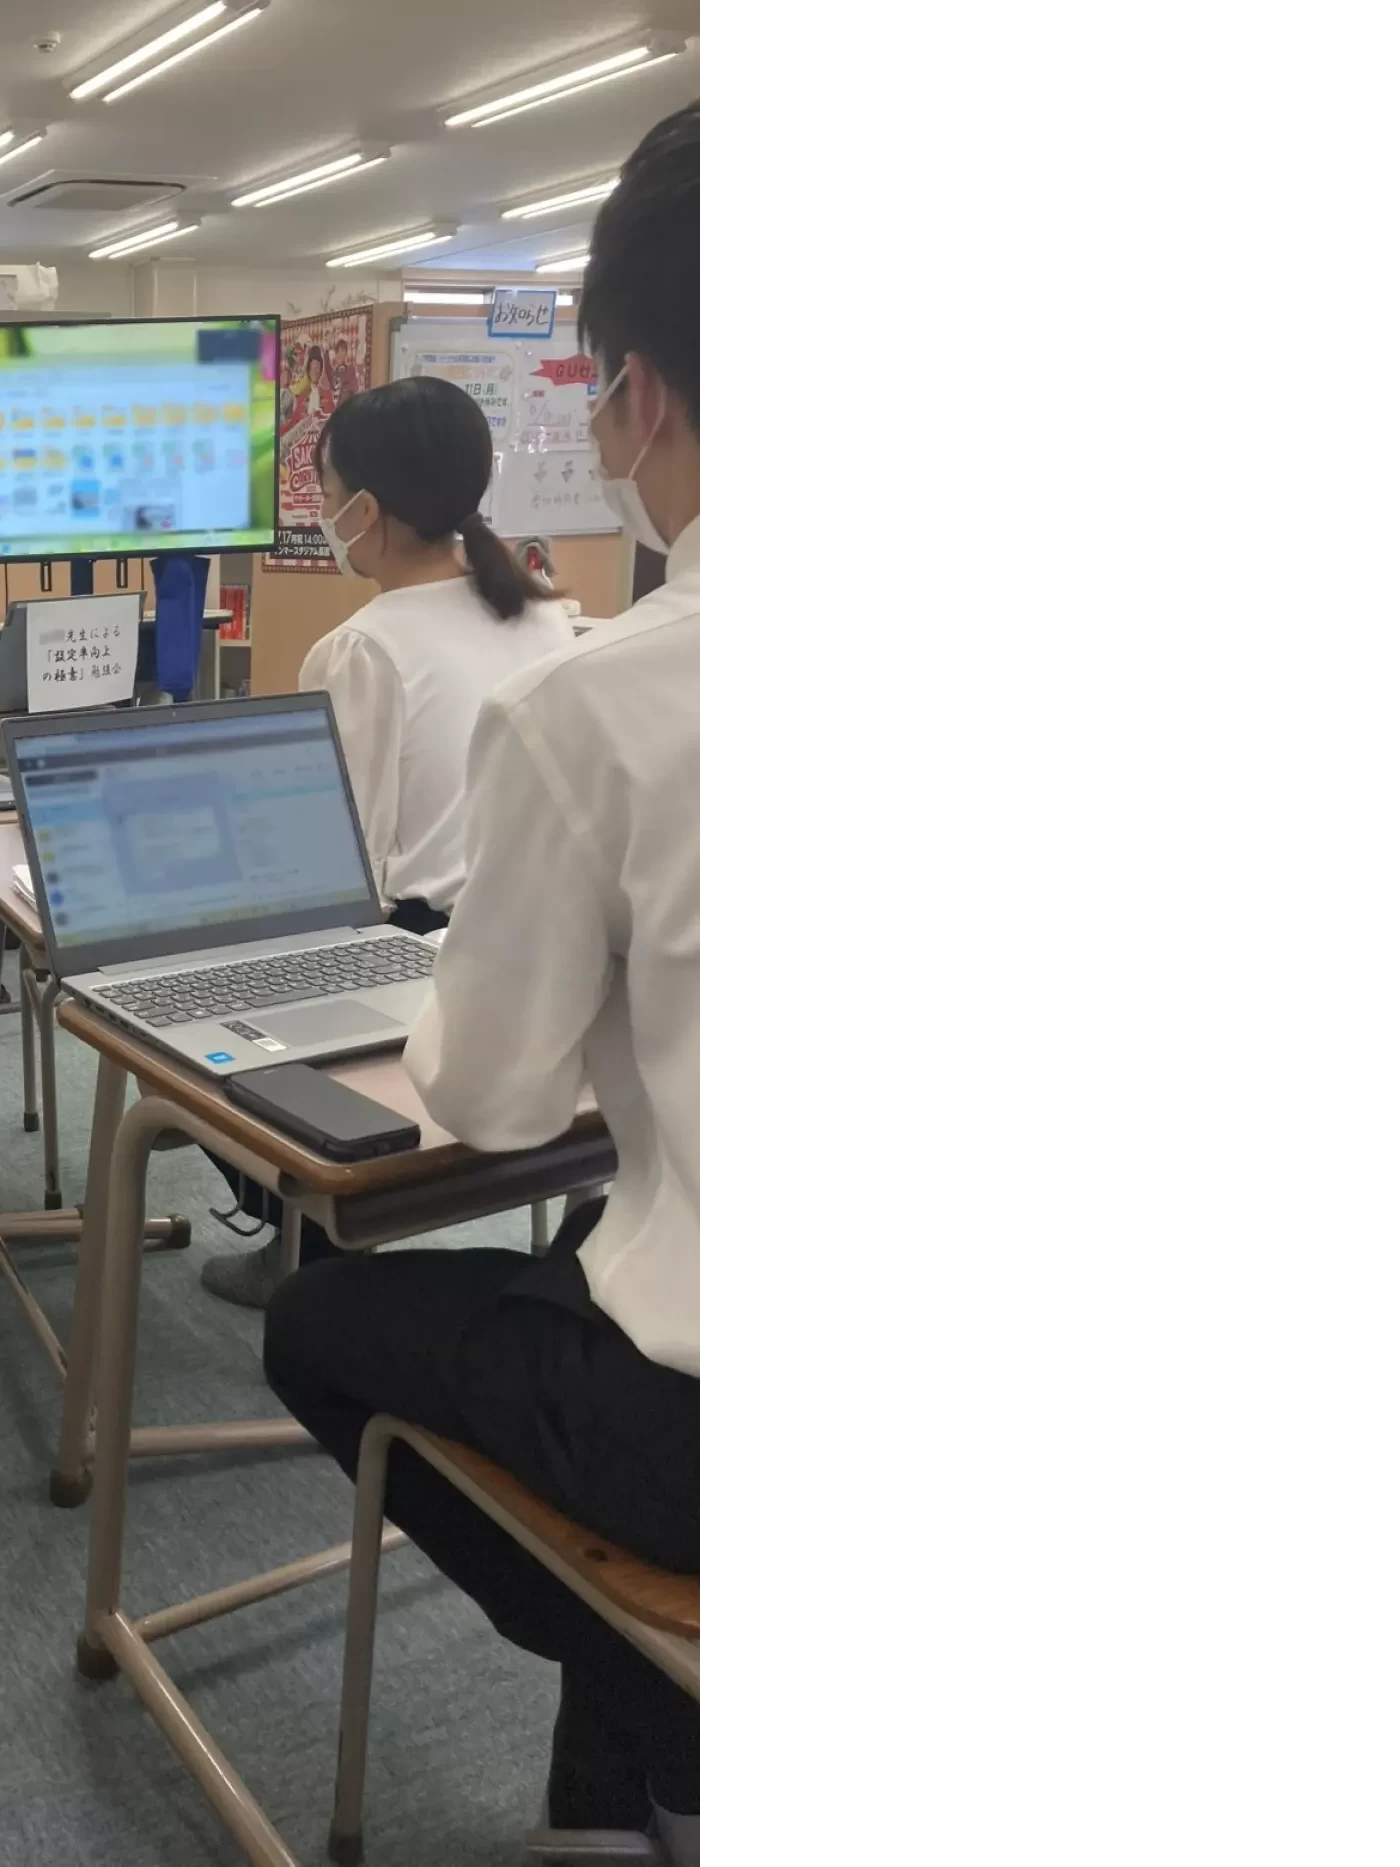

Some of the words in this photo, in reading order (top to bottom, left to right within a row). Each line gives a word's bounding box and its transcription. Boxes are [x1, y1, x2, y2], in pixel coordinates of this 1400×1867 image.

[494, 303, 549, 326] お知らせ
[292, 445, 313, 469] SAK
[275, 546, 330, 556] ンマースタジアム長居
[65, 625, 121, 643] 先生による
